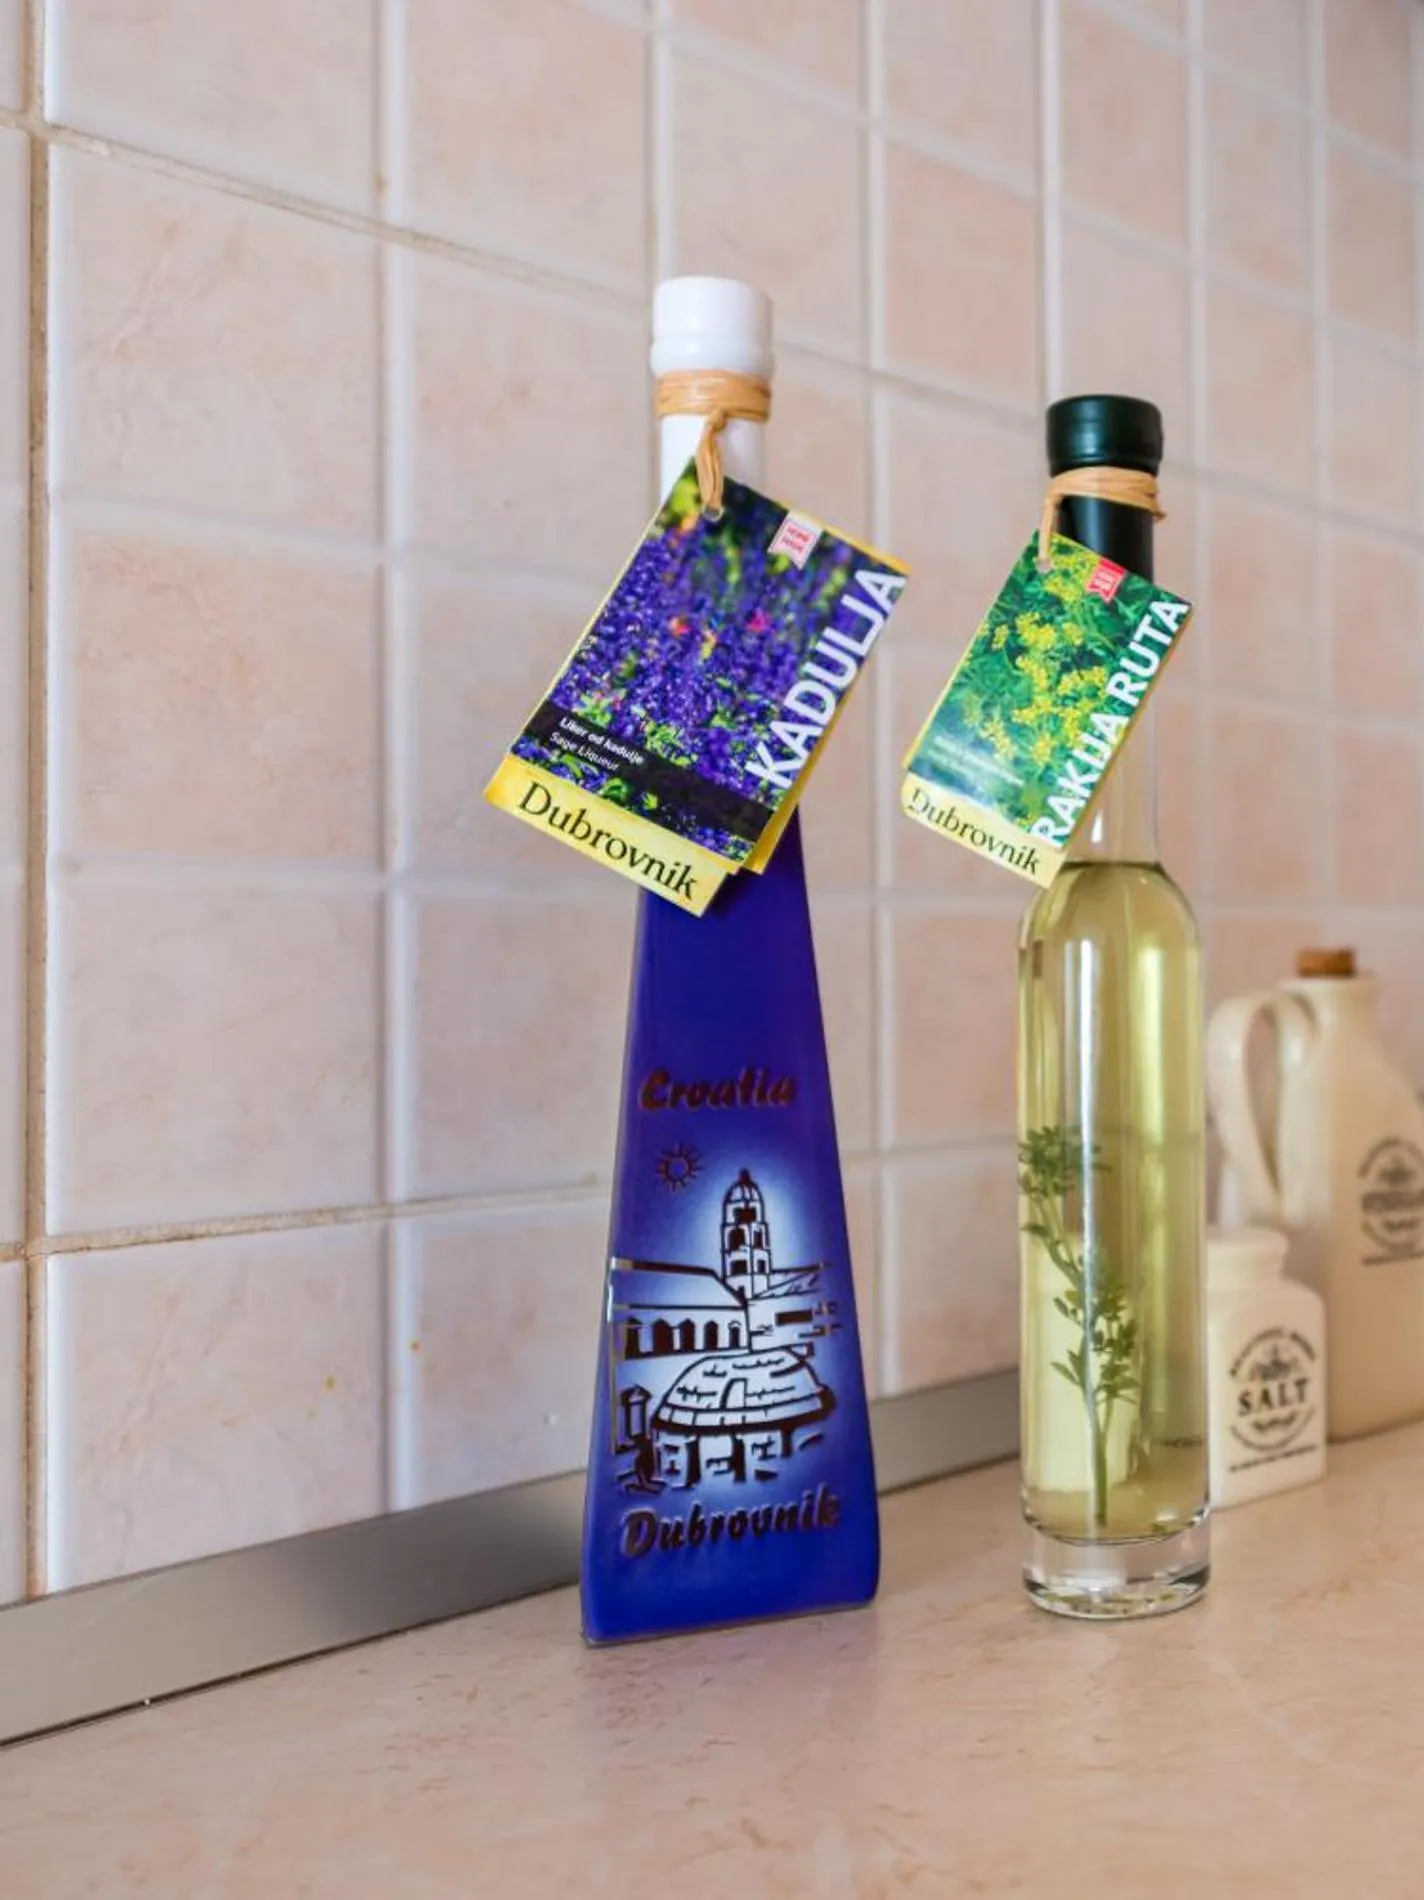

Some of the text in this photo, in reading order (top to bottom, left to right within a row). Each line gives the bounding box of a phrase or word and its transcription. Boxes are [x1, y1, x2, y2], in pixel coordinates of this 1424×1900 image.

[746, 569, 907, 789] KADULJA
[1106, 599, 1192, 707] RUTA
[517, 781, 698, 900] Dubrovnik
[906, 788, 1041, 875] Dubrovnik
[638, 1066, 796, 1112] Croatia
[1238, 1378, 1309, 1416] SALT
[620, 1483, 840, 1558] Dubrovnik
